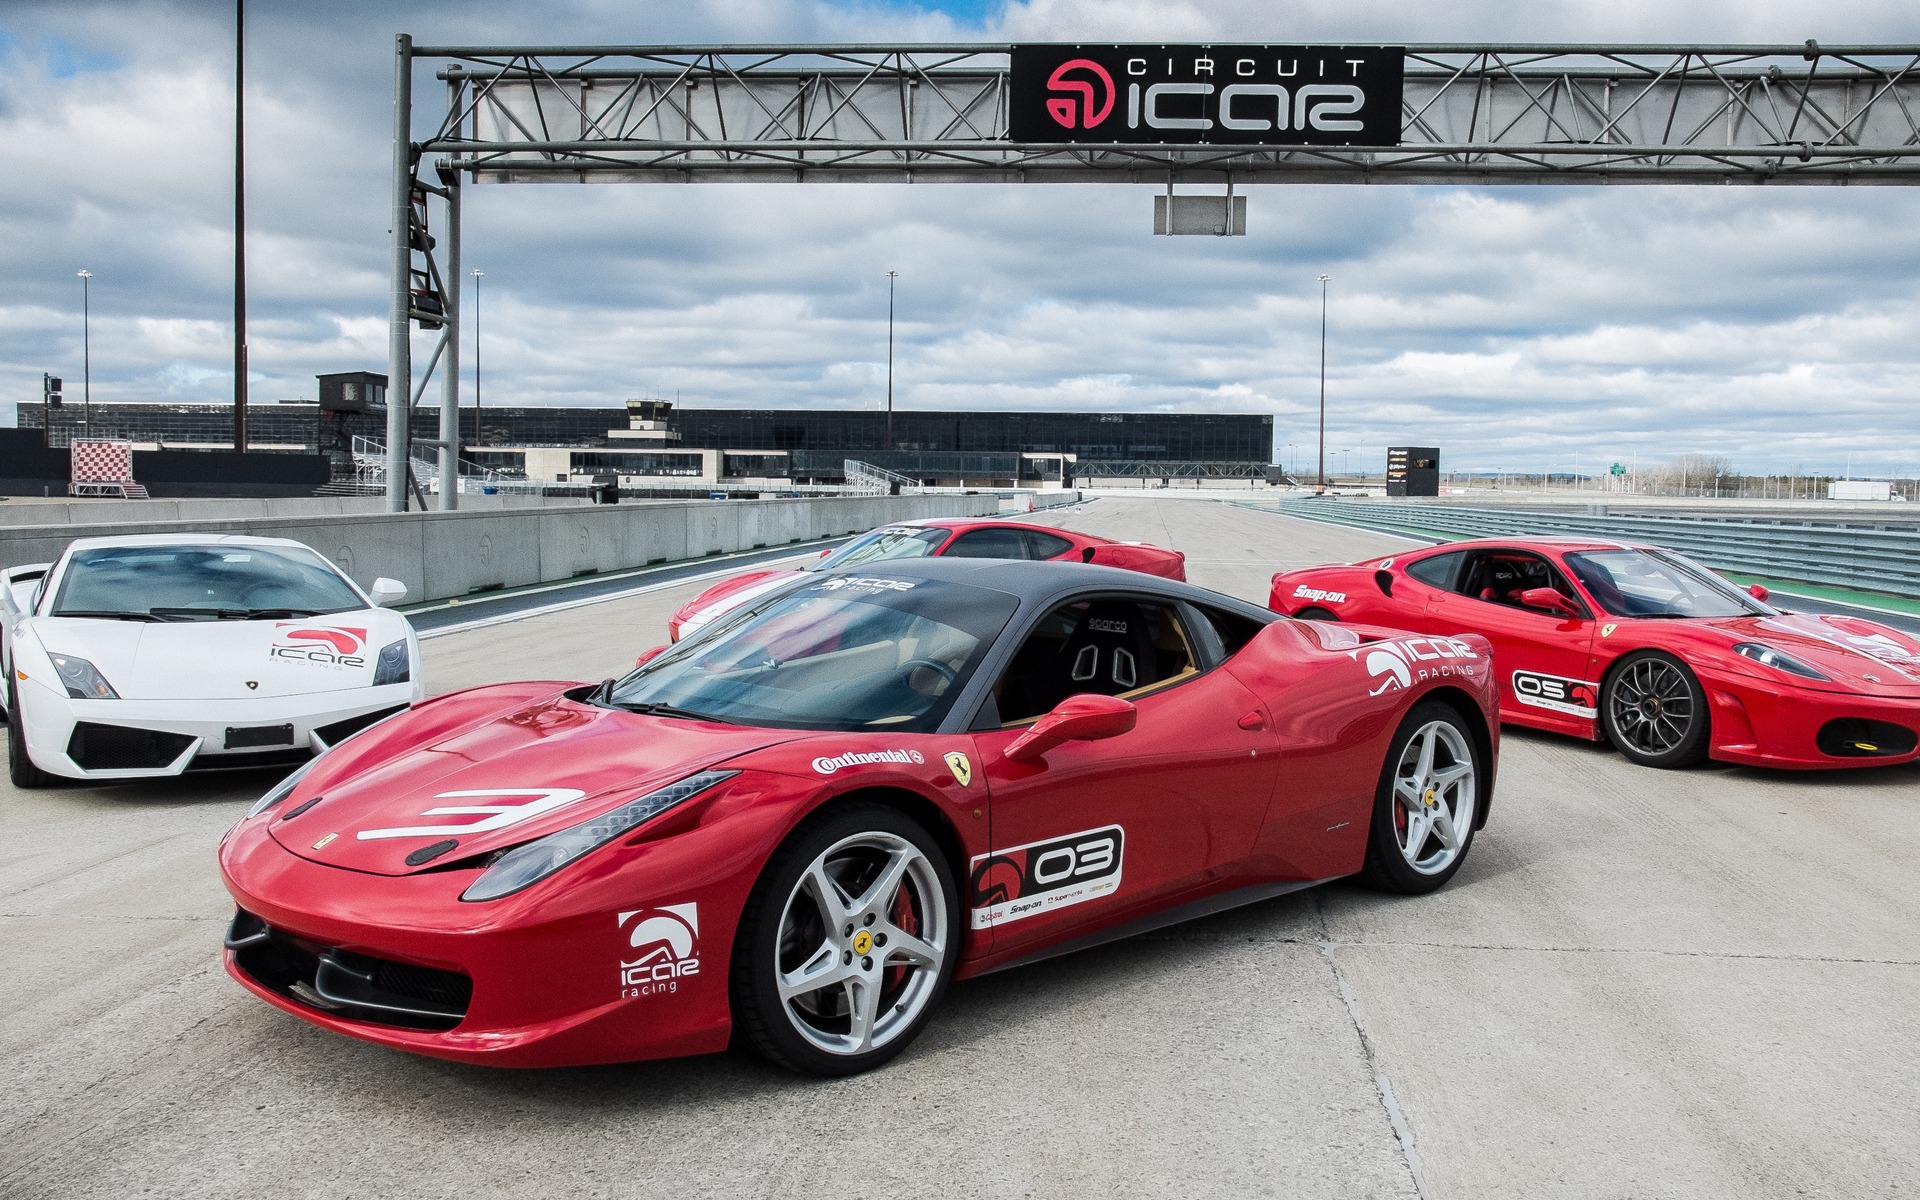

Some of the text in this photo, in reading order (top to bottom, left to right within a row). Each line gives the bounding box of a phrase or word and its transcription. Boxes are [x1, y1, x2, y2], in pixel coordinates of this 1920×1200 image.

[1127, 58, 1365, 77] CIRCUIT
[1292, 584, 1347, 603] Snap-on
[1088, 618, 1128, 632] sparco
[269, 657, 343, 671] RACING
[1418, 664, 1475, 680] RACING
[811, 749, 914, 775] Continental
[1034, 837, 1115, 885] 03
[1009, 900, 1042, 915] Snap-on
[621, 981, 677, 999] racing
